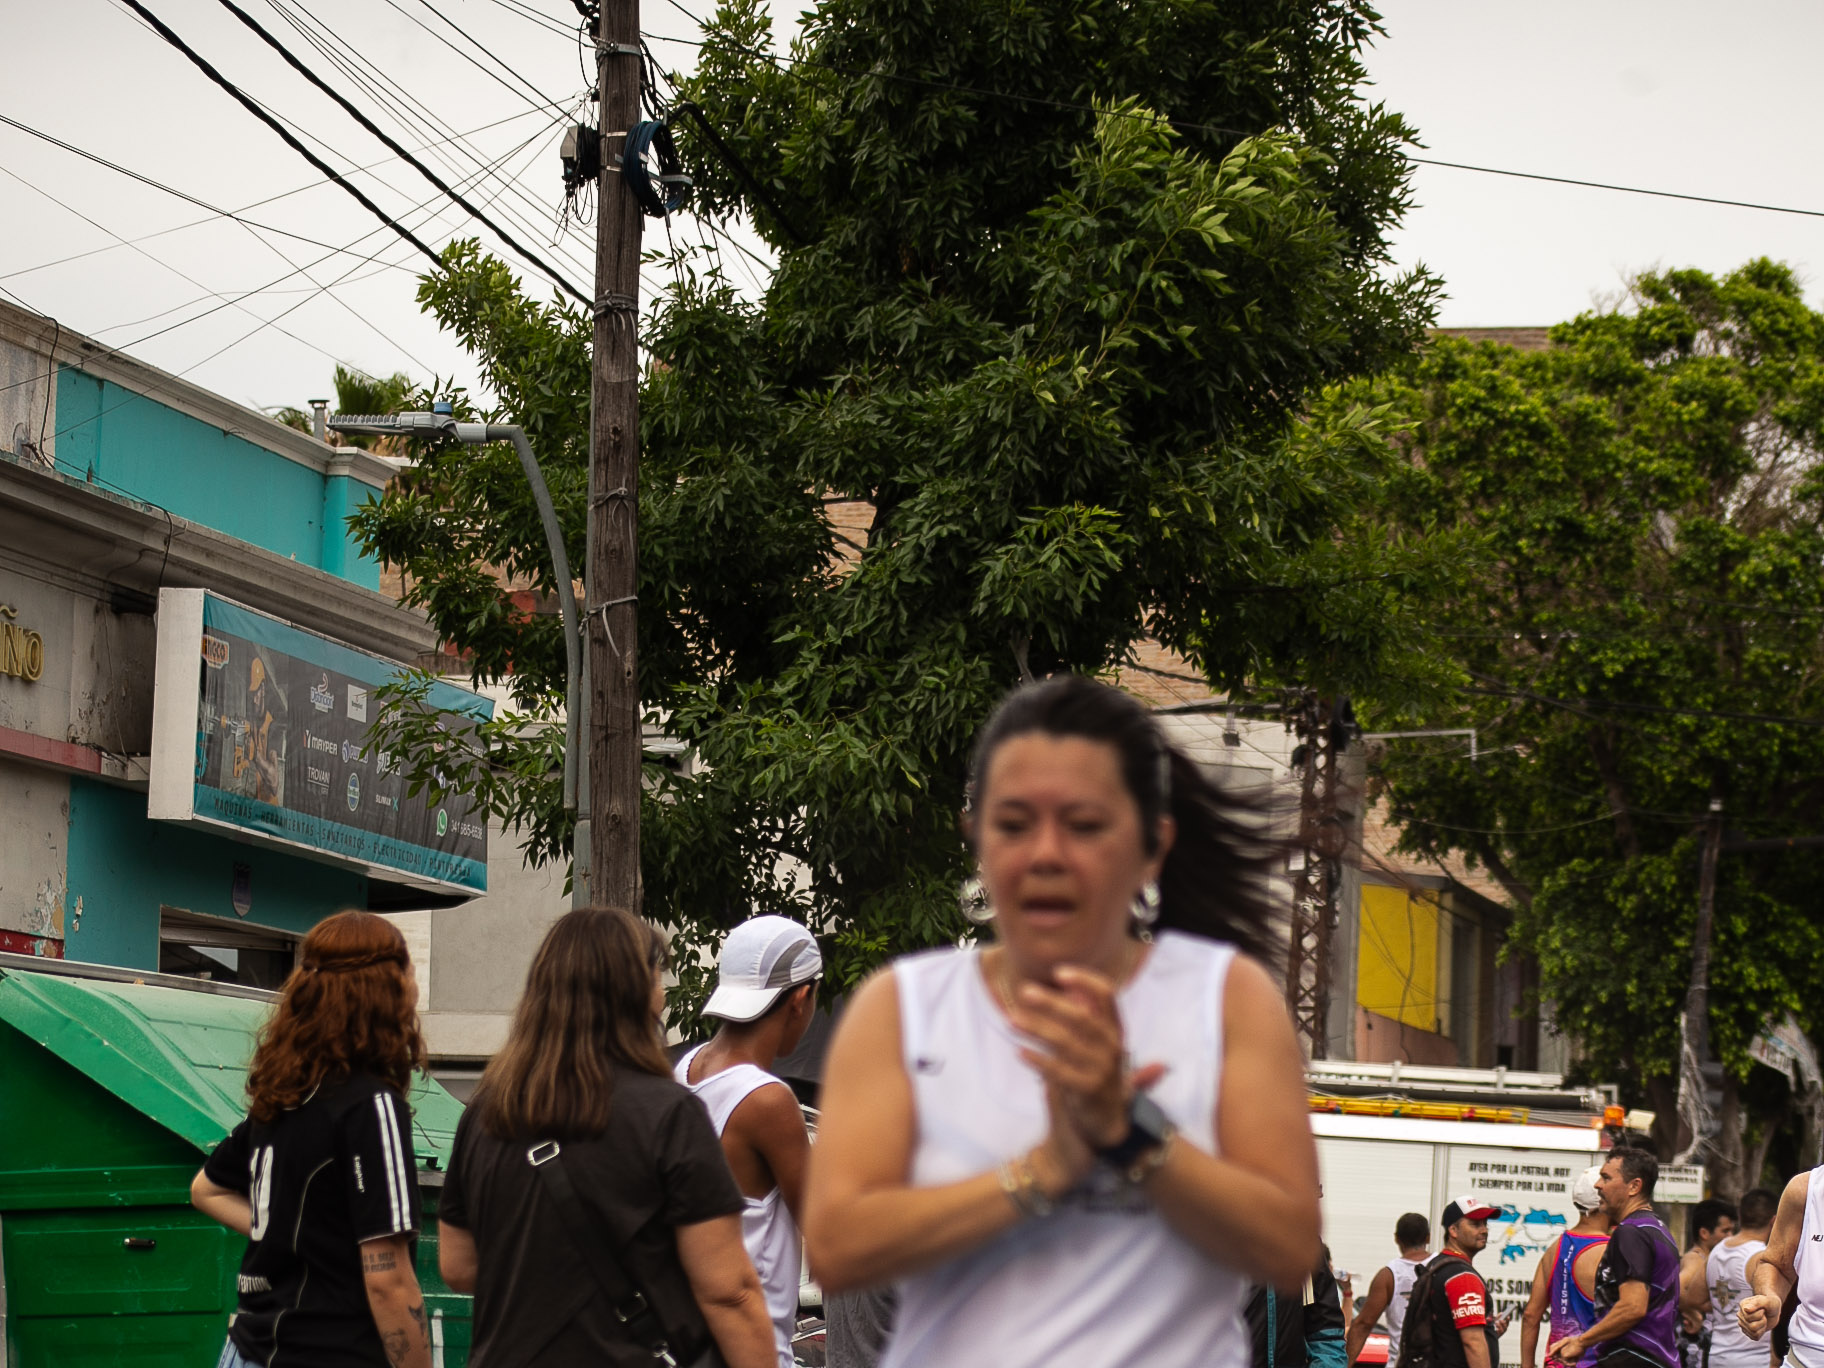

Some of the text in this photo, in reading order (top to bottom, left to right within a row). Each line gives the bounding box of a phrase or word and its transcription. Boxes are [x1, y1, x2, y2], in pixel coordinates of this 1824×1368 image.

[1491, 1163, 1507, 1174] POR
[1509, 1164, 1518, 1175] LA
[1478, 1179, 1514, 1191] SIEMPRE
[1516, 1181, 1532, 1192] POR
[1534, 1182, 1544, 1192] LA
[1546, 1183, 1566, 1193] VIDA
